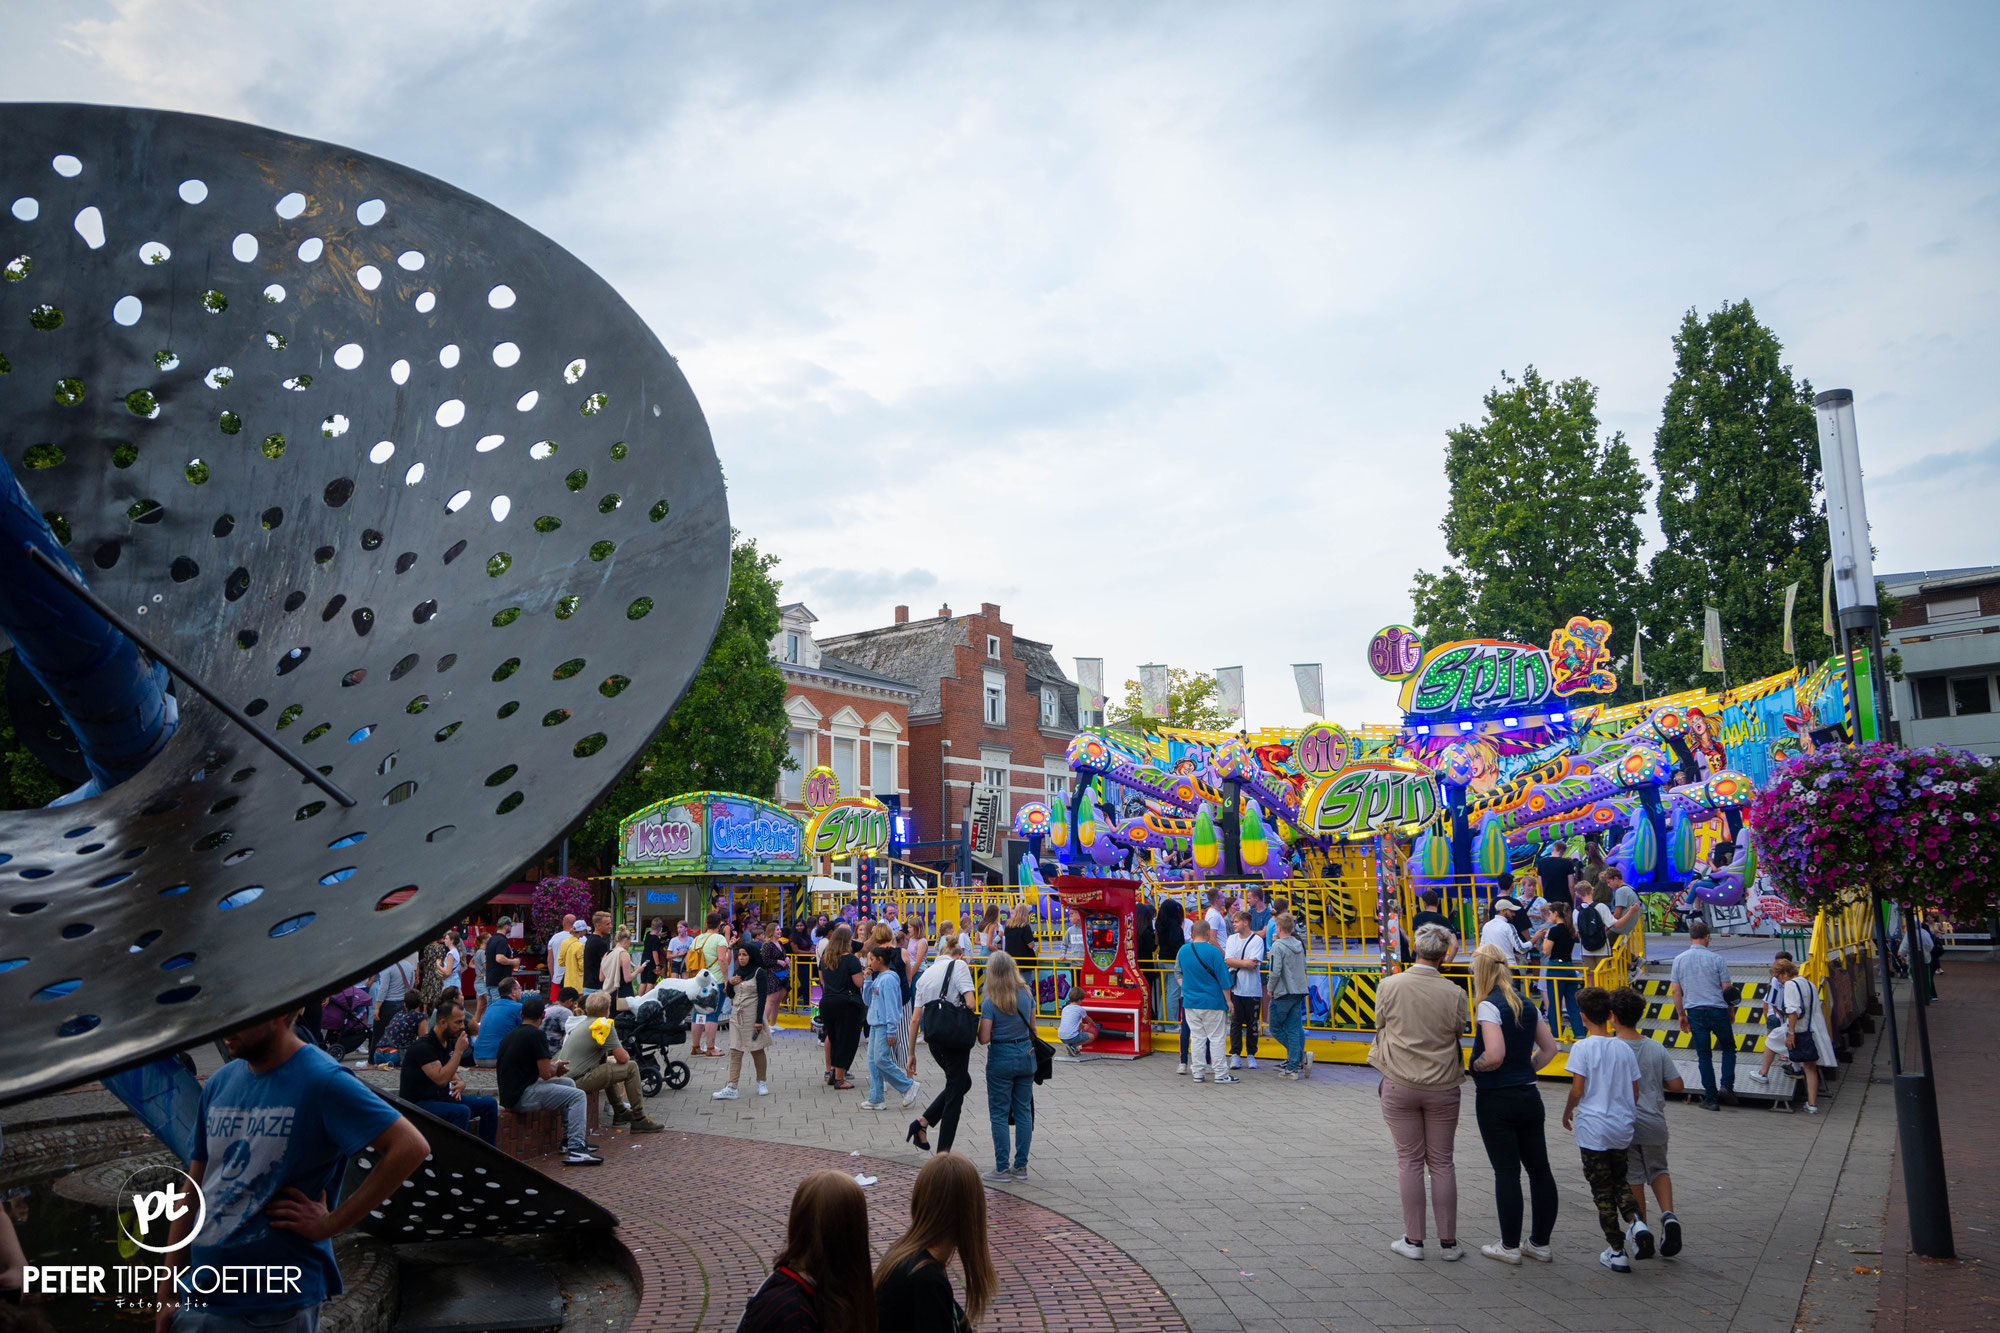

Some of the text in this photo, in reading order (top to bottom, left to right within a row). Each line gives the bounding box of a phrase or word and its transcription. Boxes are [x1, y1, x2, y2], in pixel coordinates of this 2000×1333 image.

[1416, 647, 1549, 711] Spin
[1224, 796, 1232, 808] 6
[1320, 771, 1436, 831] Spin
[1457, 805, 1465, 817] 7
[1655, 803, 1662, 814] 8
[815, 807, 887, 854] Spin
[974, 794, 991, 852] extrablatt
[647, 890, 678, 904] Kasse
[246, 1117, 294, 1137] DAZE
